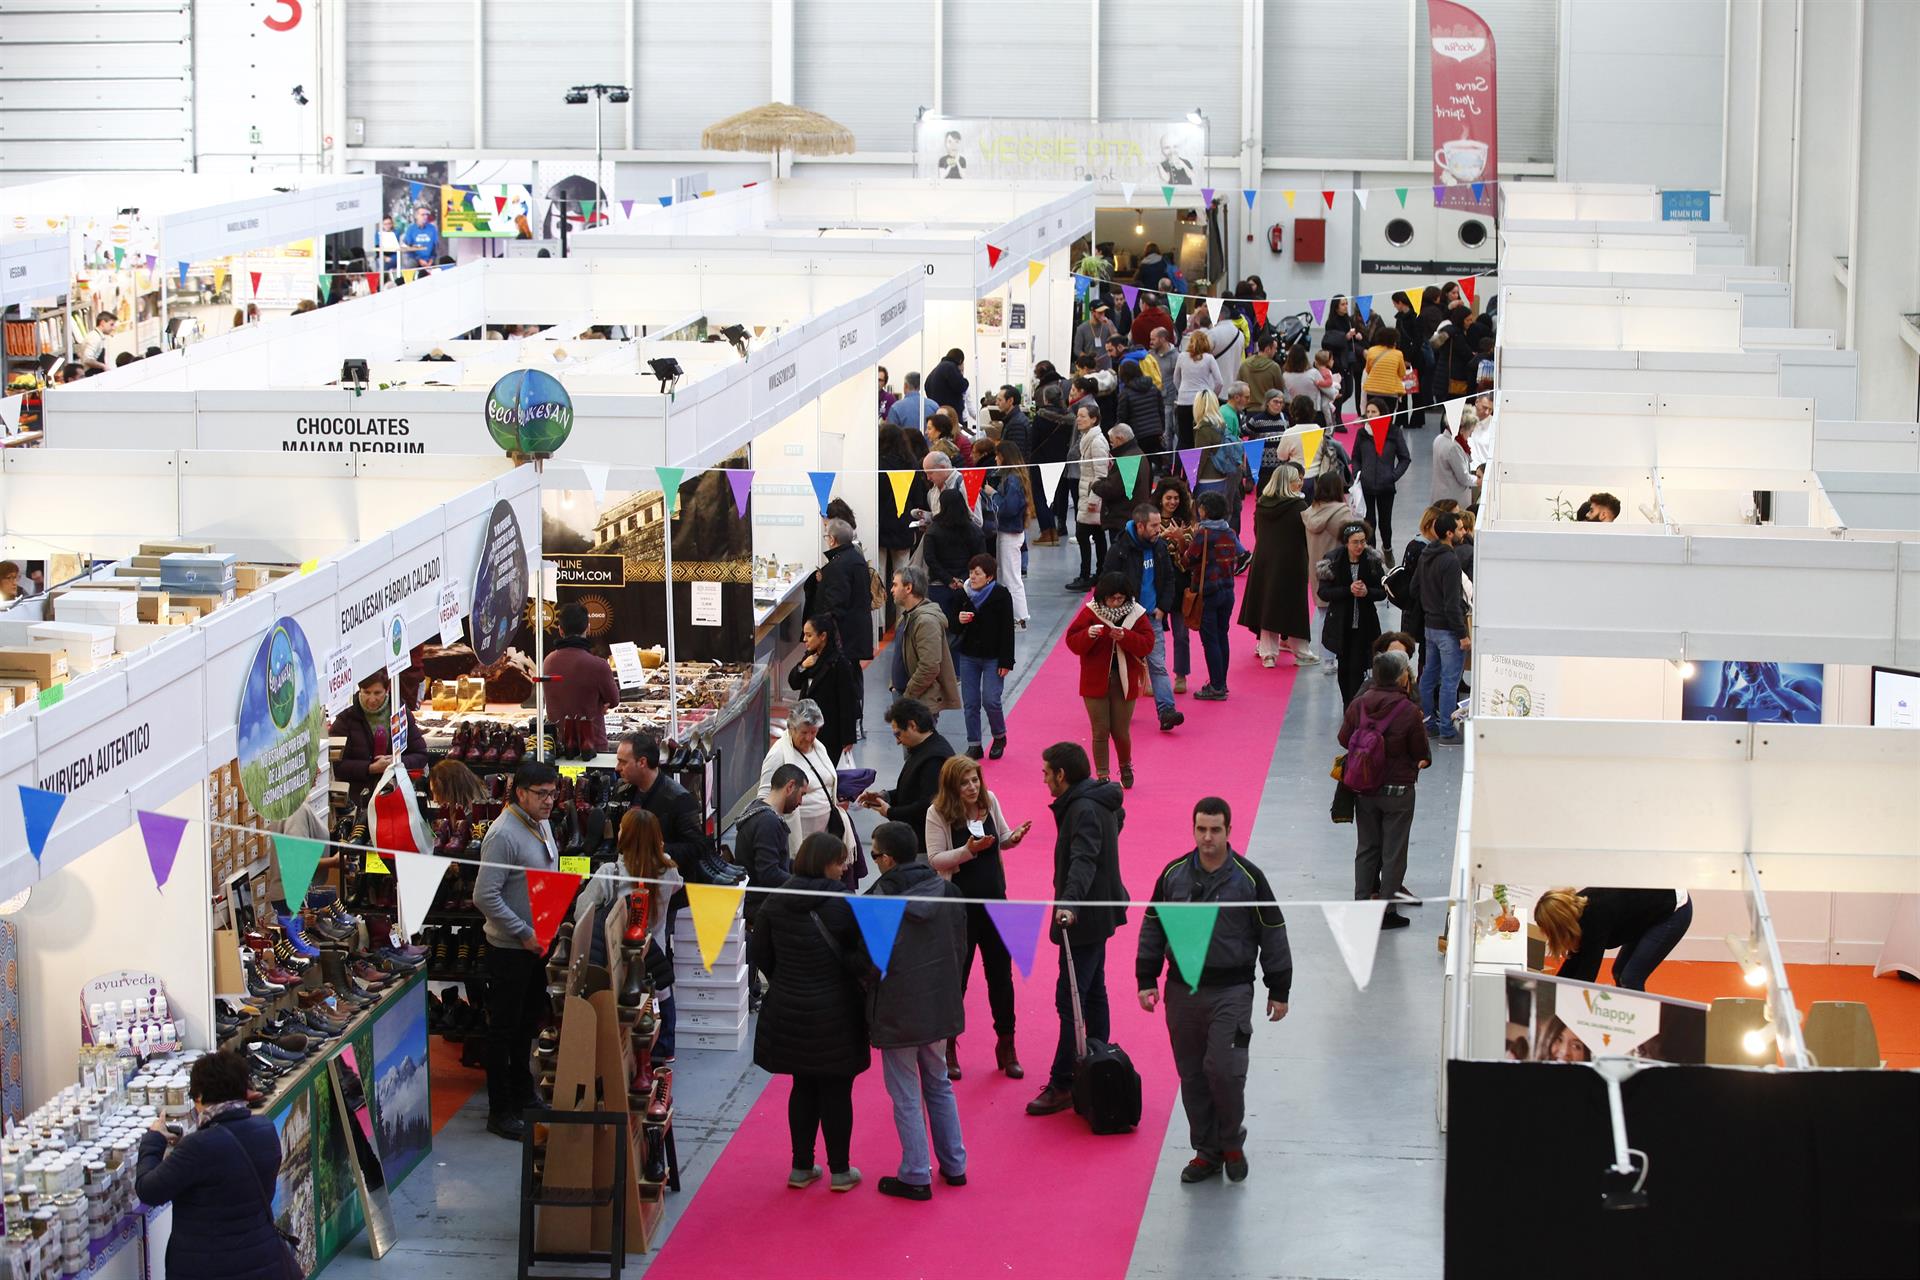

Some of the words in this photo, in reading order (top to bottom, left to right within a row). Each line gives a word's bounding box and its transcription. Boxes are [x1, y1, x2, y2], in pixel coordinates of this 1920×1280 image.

[978, 134, 1078, 165] VEGGIE
[1086, 138, 1147, 168] PITA
[296, 417, 410, 436] CHOCOLATES
[341, 590, 384, 635] ECOALKESAN
[412, 556, 440, 592] CALZADO
[439, 602, 460, 624] VEGANO
[328, 667, 352, 694] VEGANO
[96, 722, 150, 778] AUTENTICO
[94, 973, 155, 992] ayurveda
